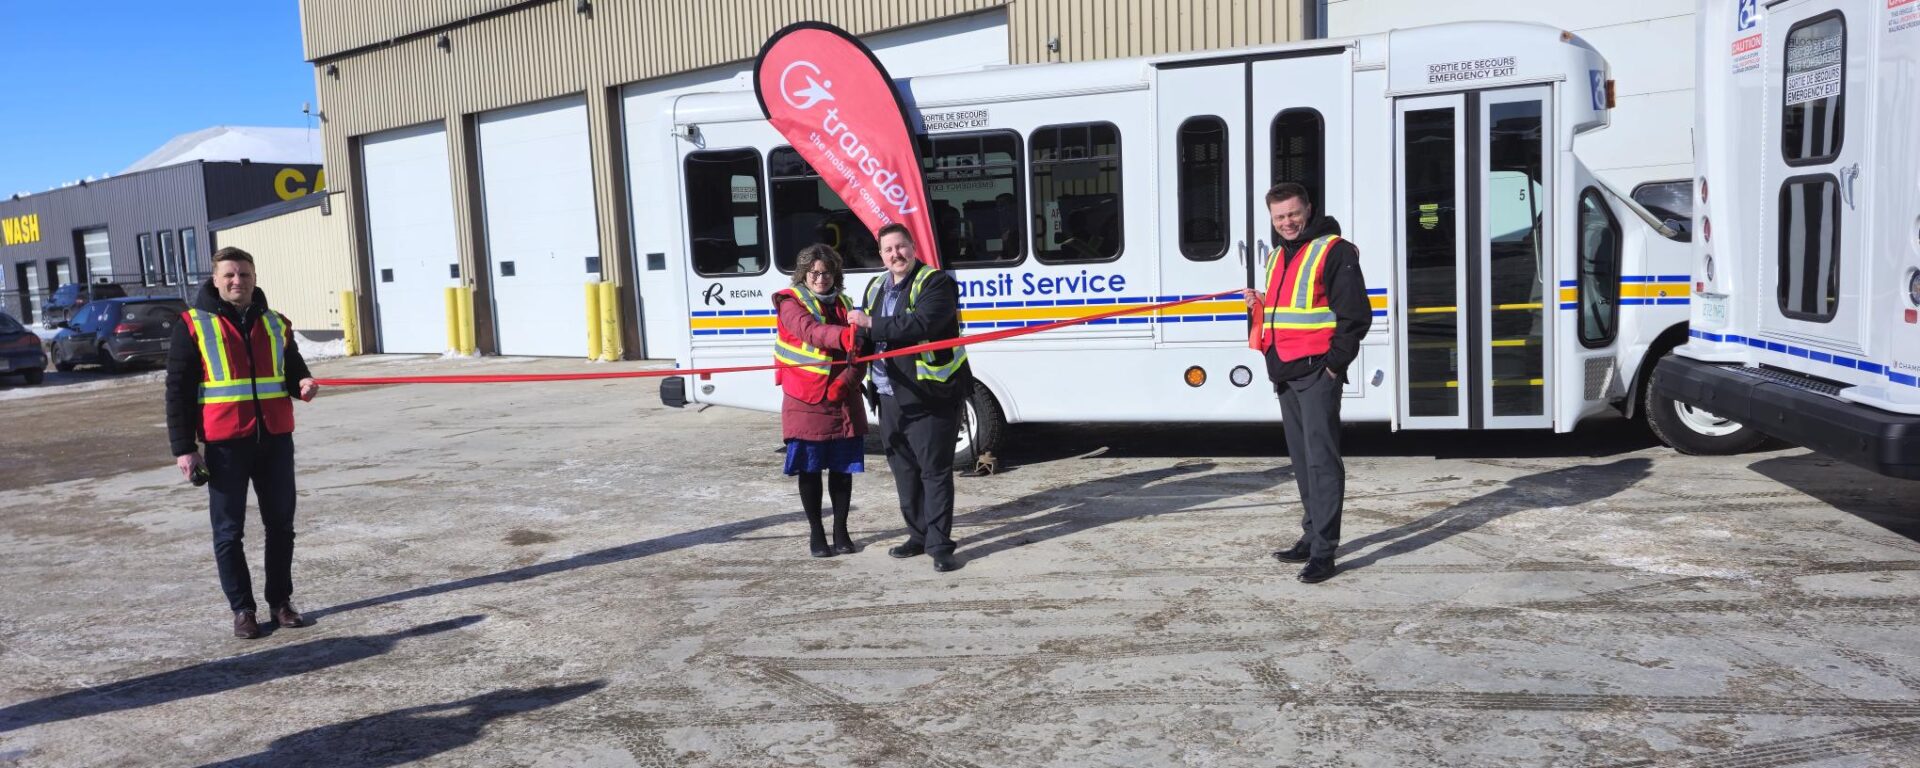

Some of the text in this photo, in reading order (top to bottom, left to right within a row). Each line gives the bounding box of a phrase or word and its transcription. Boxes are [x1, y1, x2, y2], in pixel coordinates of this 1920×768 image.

[1429, 57, 1514, 73] SORTIE DE SECOURS
[1429, 67, 1514, 83] EMERGENCY EXIT
[1788, 68, 1839, 89] SORTIE DE SECOURS
[1787, 82, 1839, 103] EMERGENCY EXIT
[922, 119, 987, 131] EMERGENCY EXIT
[923, 114, 944, 122] SORTIE
[956, 110, 987, 120] SECOURS
[809, 132, 825, 150] the
[824, 148, 860, 189] mobility
[823, 108, 918, 214] transdev
[1519, 188, 1526, 201] 5
[2, 214, 40, 245] WASH
[1022, 269, 1126, 296] Service
[729, 289, 763, 298] REGINA
